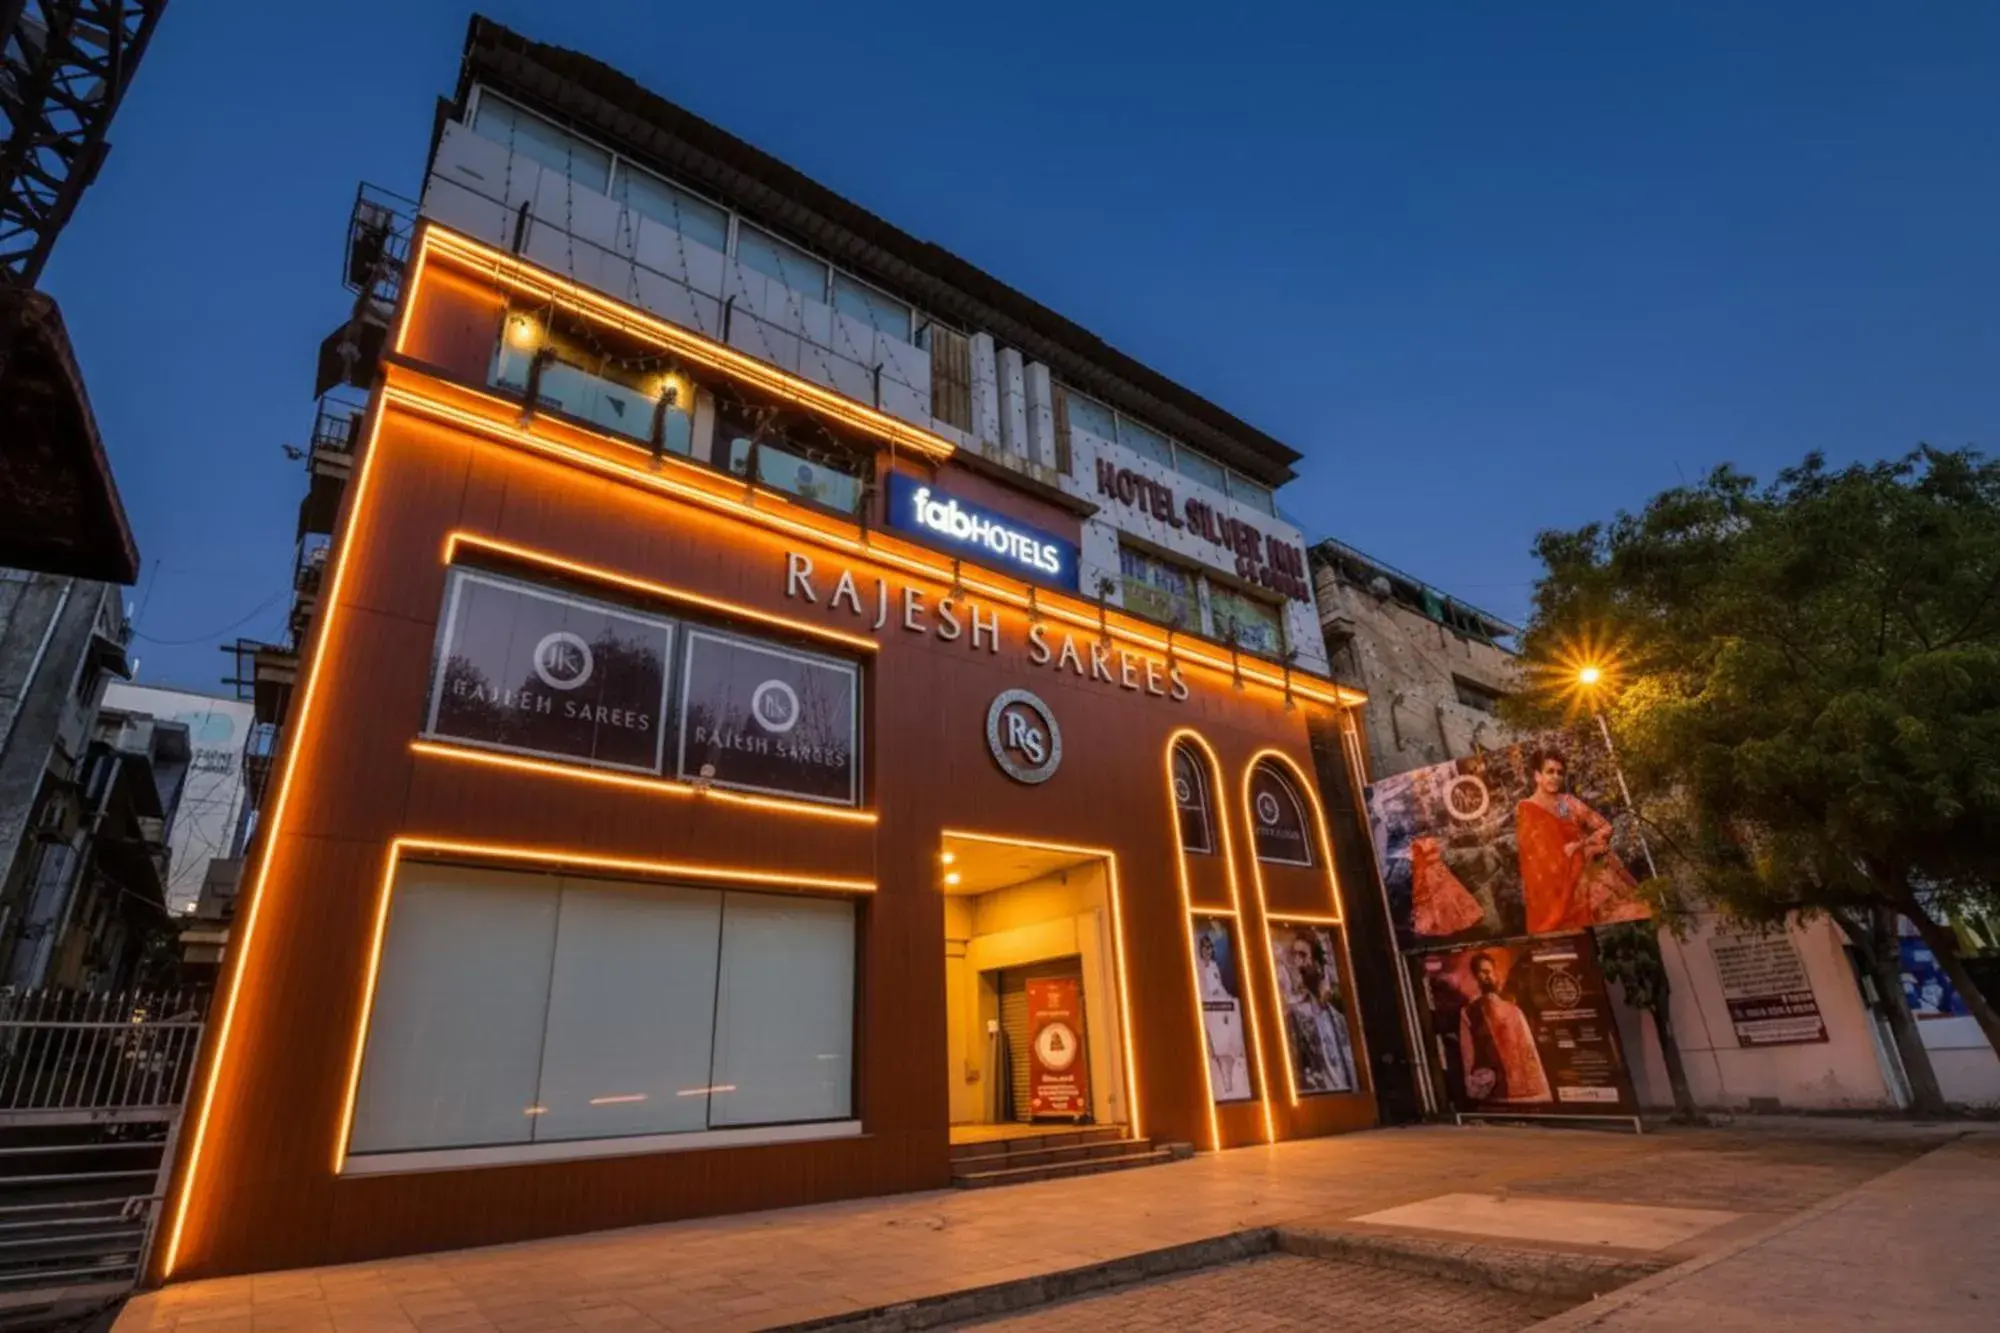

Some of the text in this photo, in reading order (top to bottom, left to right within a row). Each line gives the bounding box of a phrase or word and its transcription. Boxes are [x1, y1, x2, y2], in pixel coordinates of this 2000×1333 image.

[914, 487, 1060, 574] fabHOTELS
[1096, 457, 1184, 529] HOTEL
[787, 551, 1190, 702] RAJESH SAREES
[564, 700, 650, 731] SAREES
